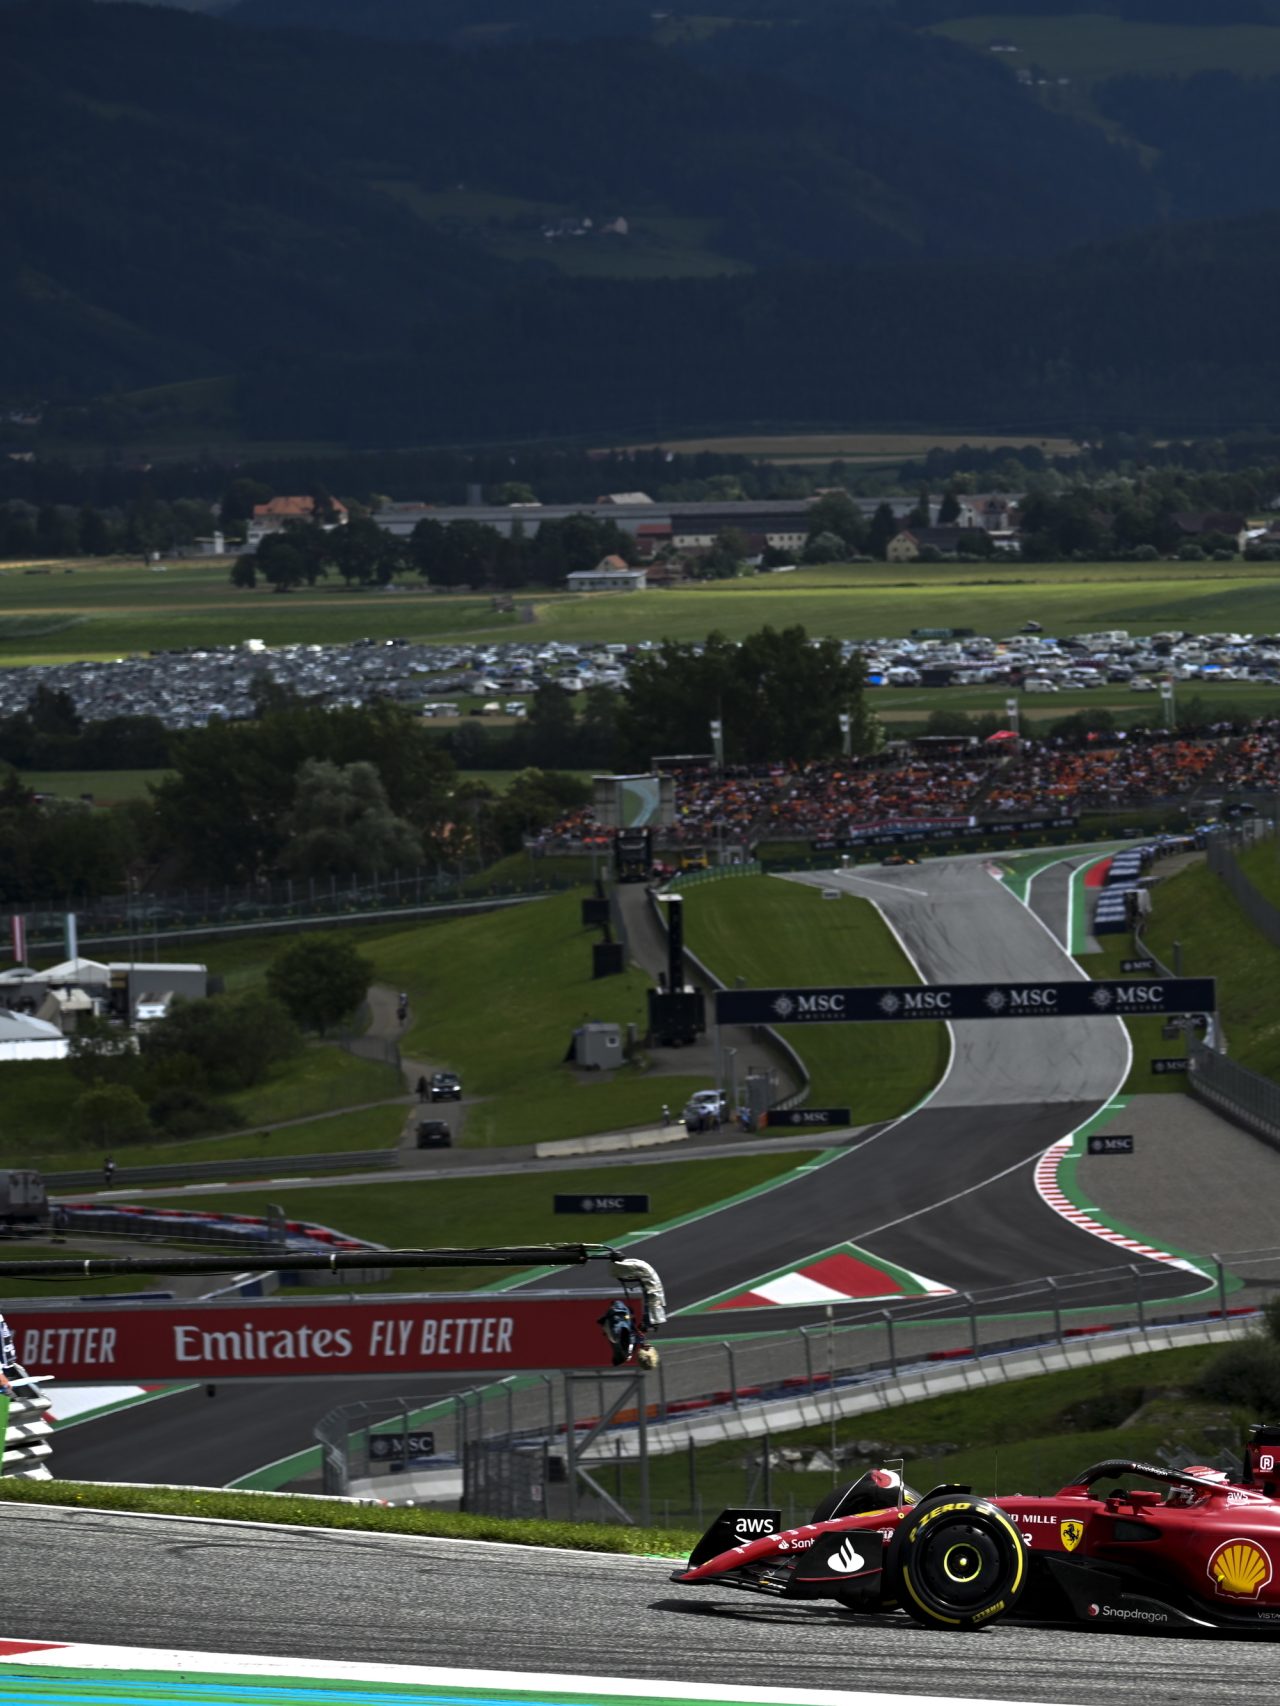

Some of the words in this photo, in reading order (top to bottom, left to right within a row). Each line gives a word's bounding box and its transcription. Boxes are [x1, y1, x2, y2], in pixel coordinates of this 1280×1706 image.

[797, 994, 845, 1011] MSC
[904, 992, 952, 1009] MSC
[1010, 989, 1058, 1006] MSC
[1116, 986, 1164, 1003] MSC
[804, 1111, 828, 1122] MSC
[1105, 1140, 1132, 1149] MSC
[596, 1199, 624, 1208] MSC
[23, 1327, 116, 1366] BETTER
[173, 1323, 352, 1361] Emirates
[369, 1320, 413, 1356] FLY
[420, 1317, 513, 1355] BETTER
[919, 1502, 972, 1526] ZERO
[1022, 1514, 1057, 1524] MILLE
[736, 1518, 774, 1533] aws
[1102, 1606, 1168, 1622] Snapdragon
